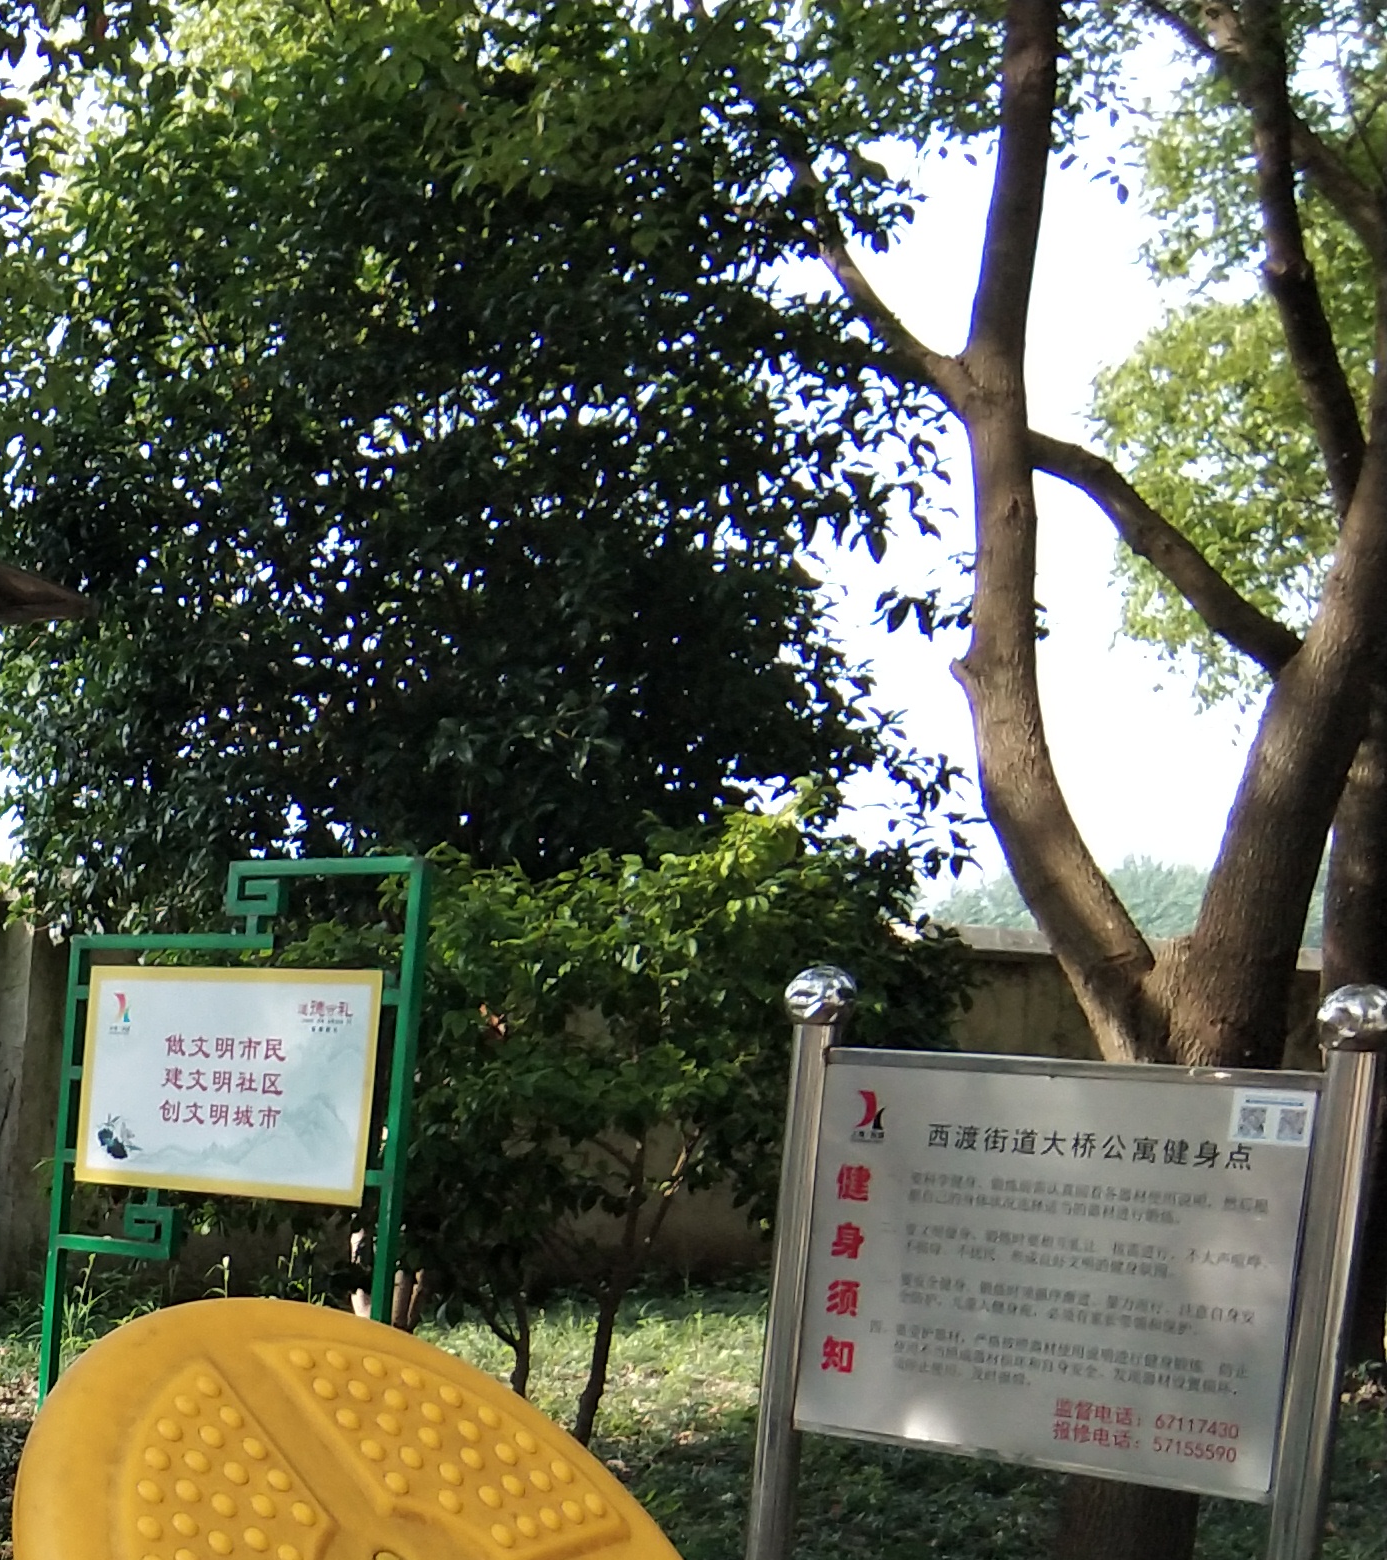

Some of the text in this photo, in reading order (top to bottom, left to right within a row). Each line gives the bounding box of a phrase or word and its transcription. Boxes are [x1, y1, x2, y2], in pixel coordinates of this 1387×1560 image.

[164, 1033, 287, 1062] 做文明市民
[161, 1066, 284, 1096] 建文明社区
[159, 1099, 282, 1129] 创文明城市
[927, 1123, 1253, 1171] 西渡街道大桥公寓健身点
[820, 1163, 872, 1375] 健身须知
[1155, 1413, 1240, 1440] 67117430
[1152, 1436, 1237, 1464] 57155590
